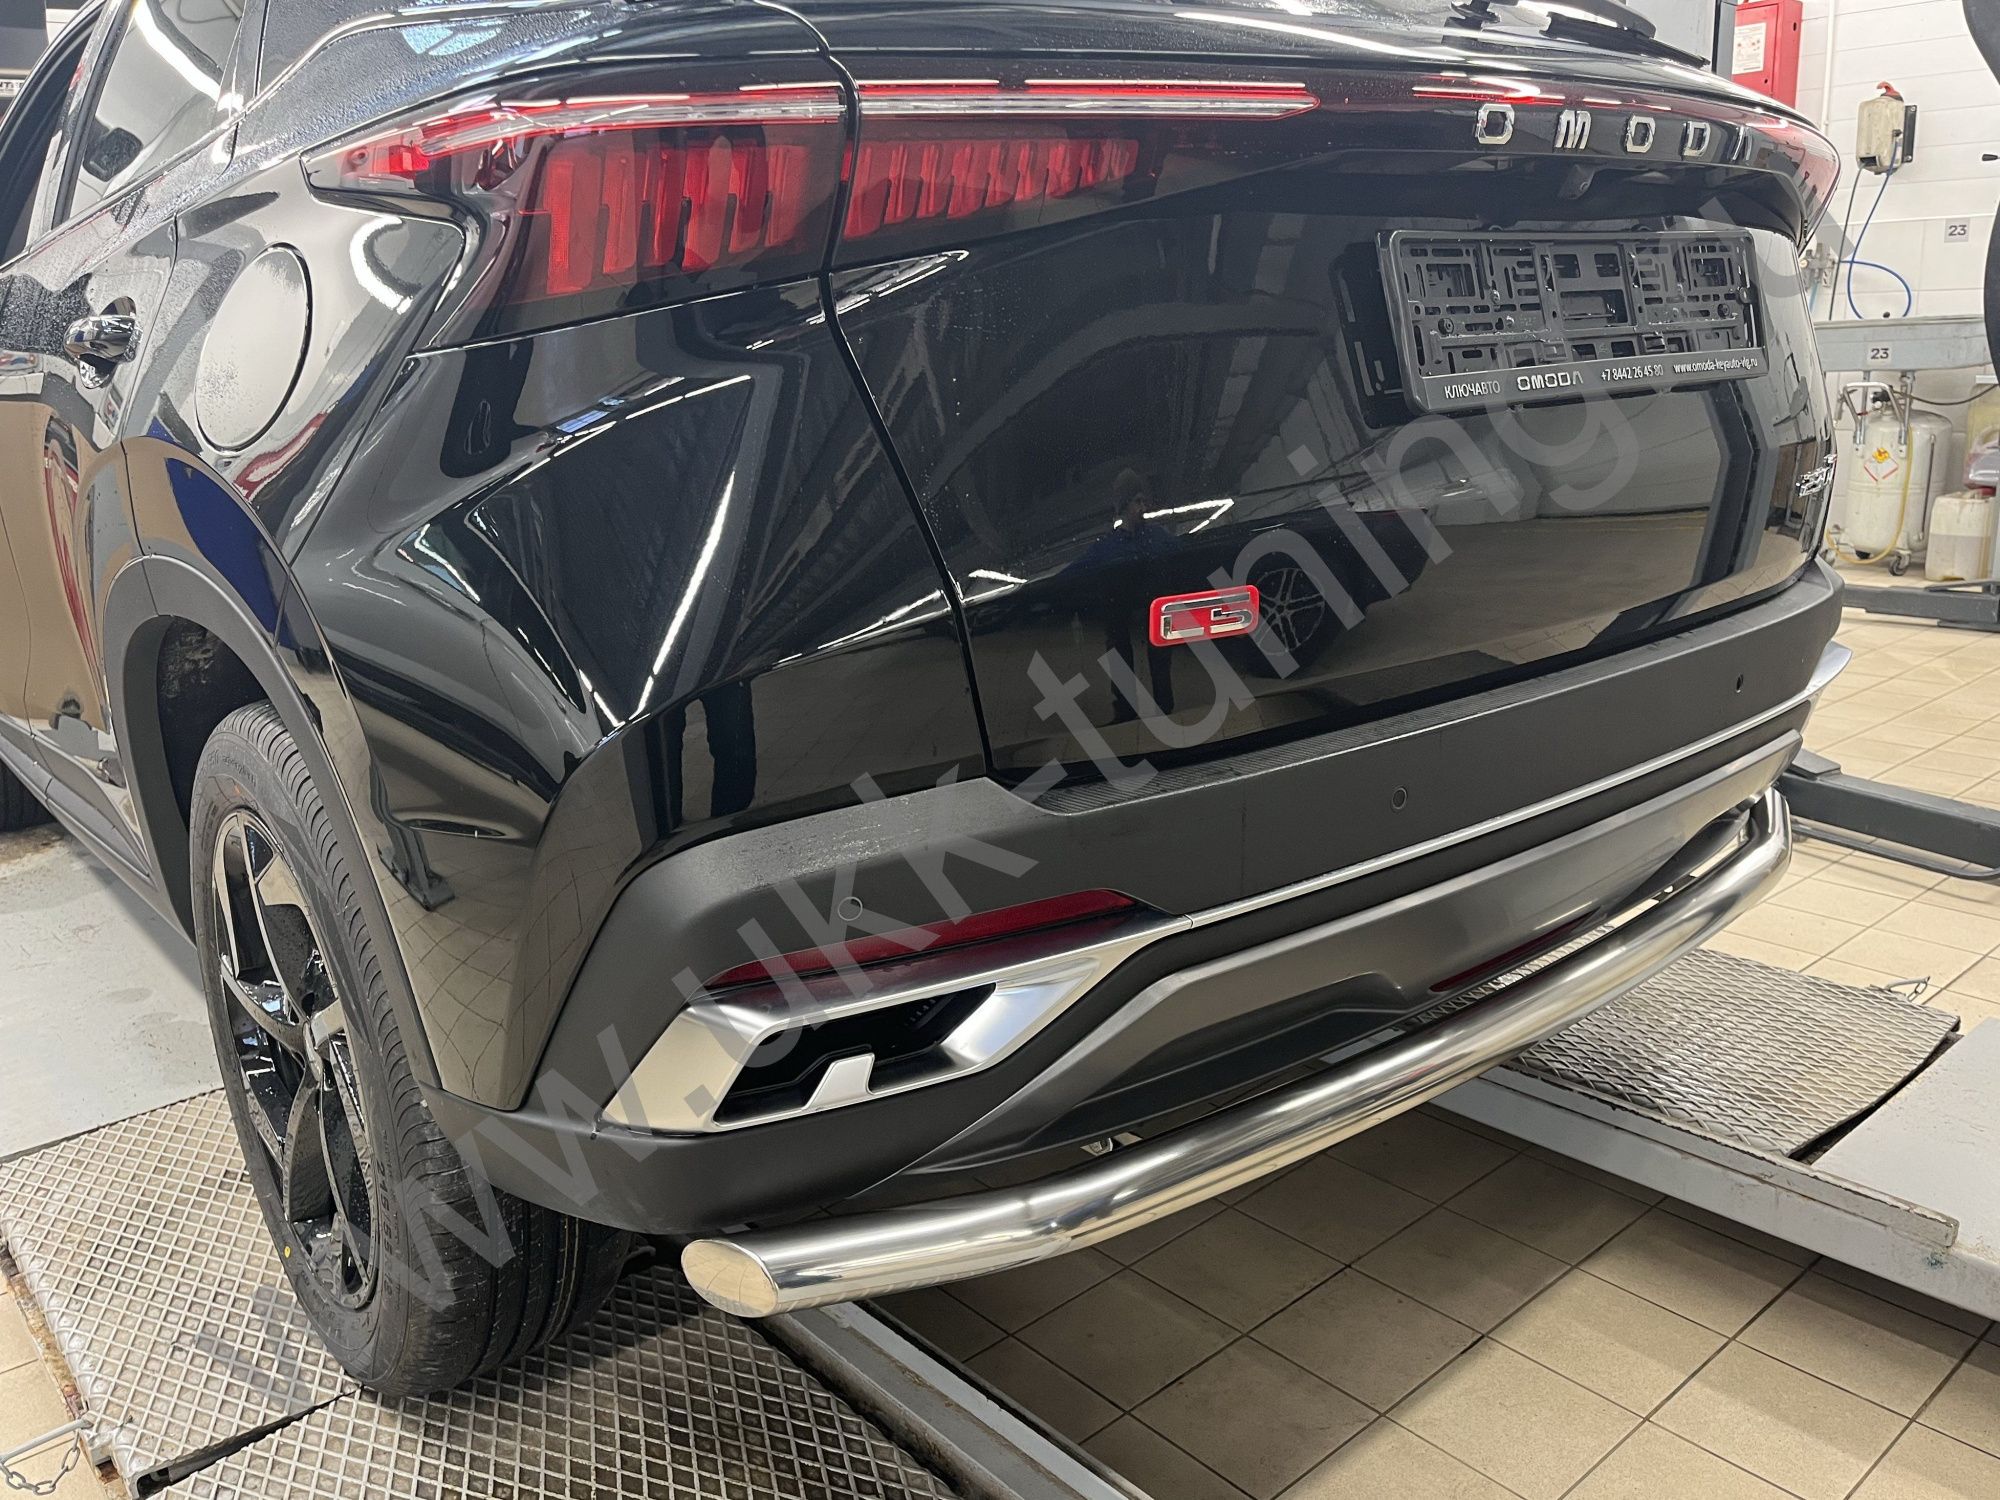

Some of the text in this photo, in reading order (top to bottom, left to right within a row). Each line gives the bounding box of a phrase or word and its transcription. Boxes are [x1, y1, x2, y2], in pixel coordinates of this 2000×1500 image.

[1948, 224, 1967, 236] 23
[1870, 348, 1889, 360] 23
[1517, 371, 1584, 391] OMODA
[1601, 364, 1664, 381] +7 8442 26 45 80
[1444, 380, 1500, 399] КЛЮЧАВТО
[1160, 592, 1253, 641] C5
